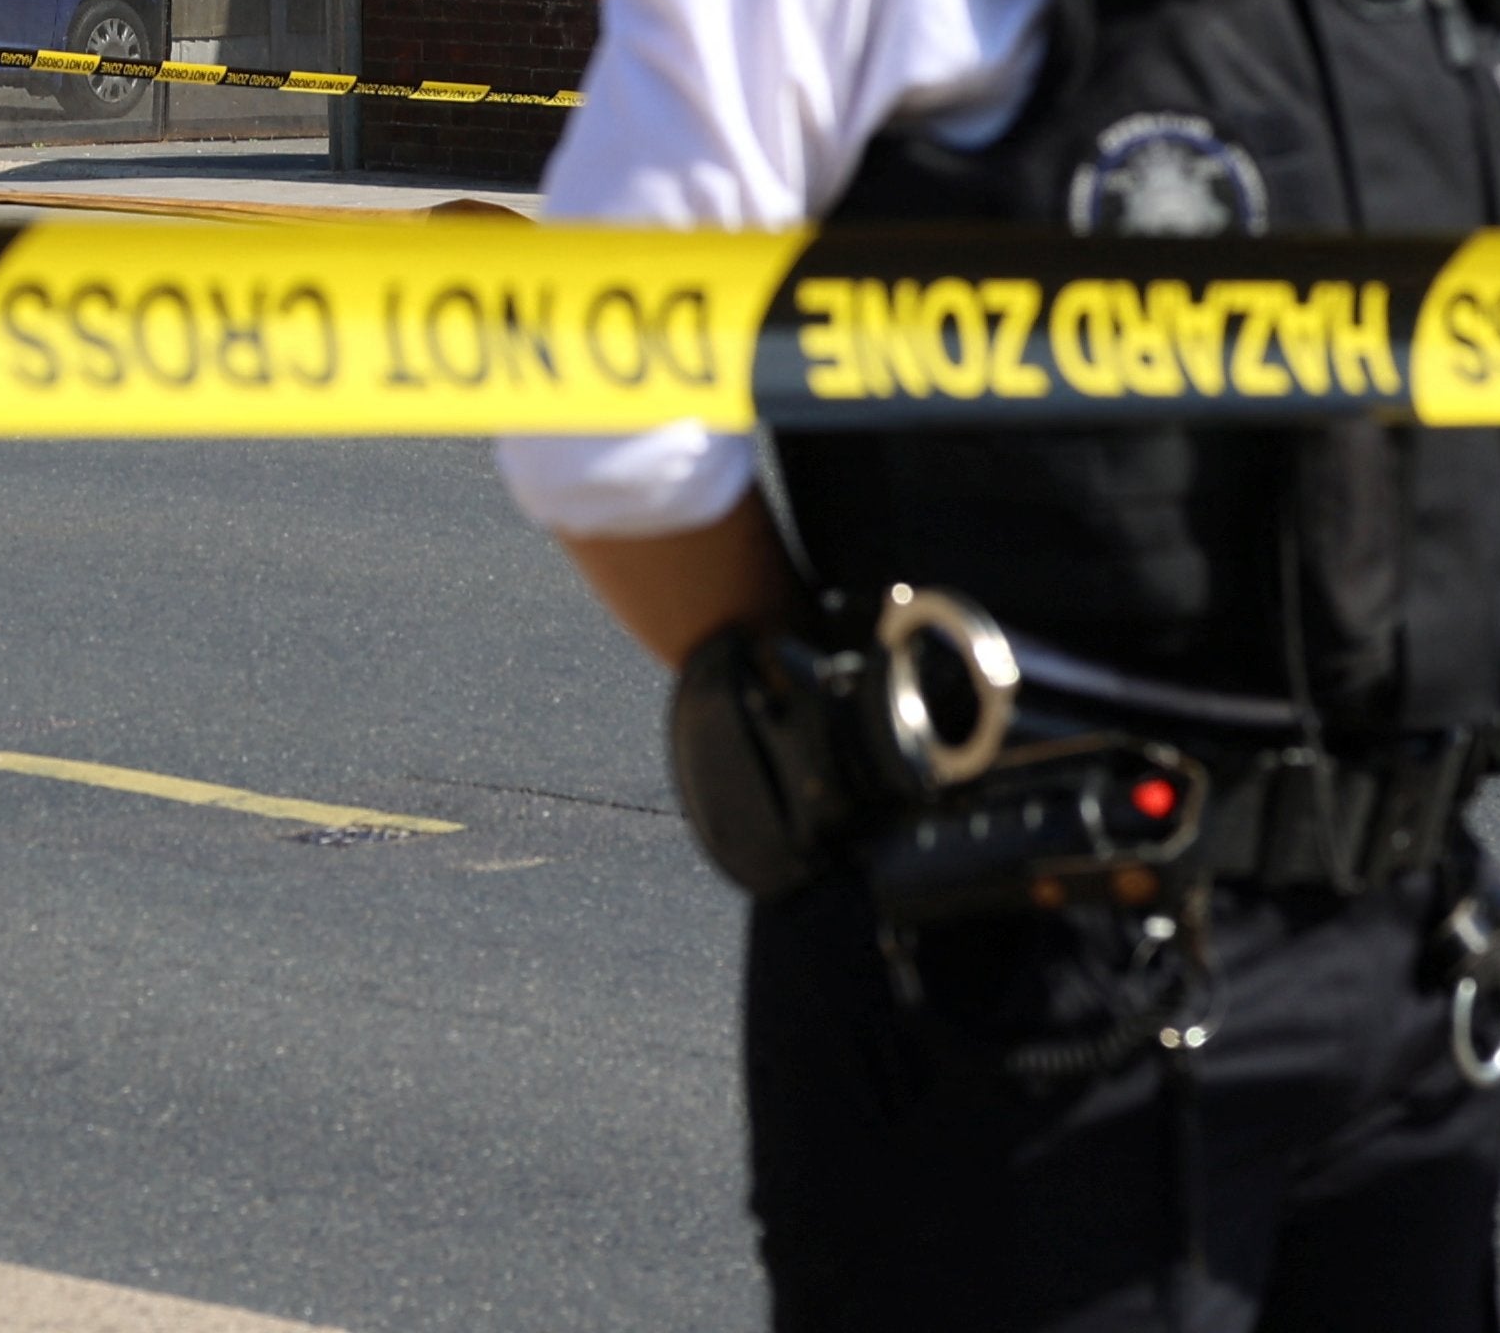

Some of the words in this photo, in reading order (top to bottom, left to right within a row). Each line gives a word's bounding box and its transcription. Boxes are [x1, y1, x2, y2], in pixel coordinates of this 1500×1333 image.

[1, 51, 33, 66] HAZARD
[38, 56, 63, 68] CROSS
[64, 58, 81, 70] NOT
[82, 60, 95, 71] DO
[101, 61, 122, 74] ZONE
[123, 63, 156, 77] HAZARD
[161, 68, 187, 79] CROSS
[188, 69, 206, 80] NOT
[207, 71, 220, 81] DO
[225, 72, 247, 84] ZONE
[249, 74, 283, 87] HAZARD
[289, 78, 316, 88] CROSS
[317, 80, 334, 90] NOT
[335, 81, 350, 90] DO
[354, 82, 378, 94] ZONE
[380, 84, 414, 97] HAZARD
[449, 89, 466, 99] NOT
[467, 91, 483, 100] DO
[485, 92, 510, 103] ZONE
[511, 93, 549, 104] HAZARD
[3, 279, 338, 388] CROSS
[381, 280, 560, 389] NOT
[584, 286, 718, 386] DO
[796, 276, 1052, 400] ZONE
[1049, 278, 1400, 398] HAZARD
